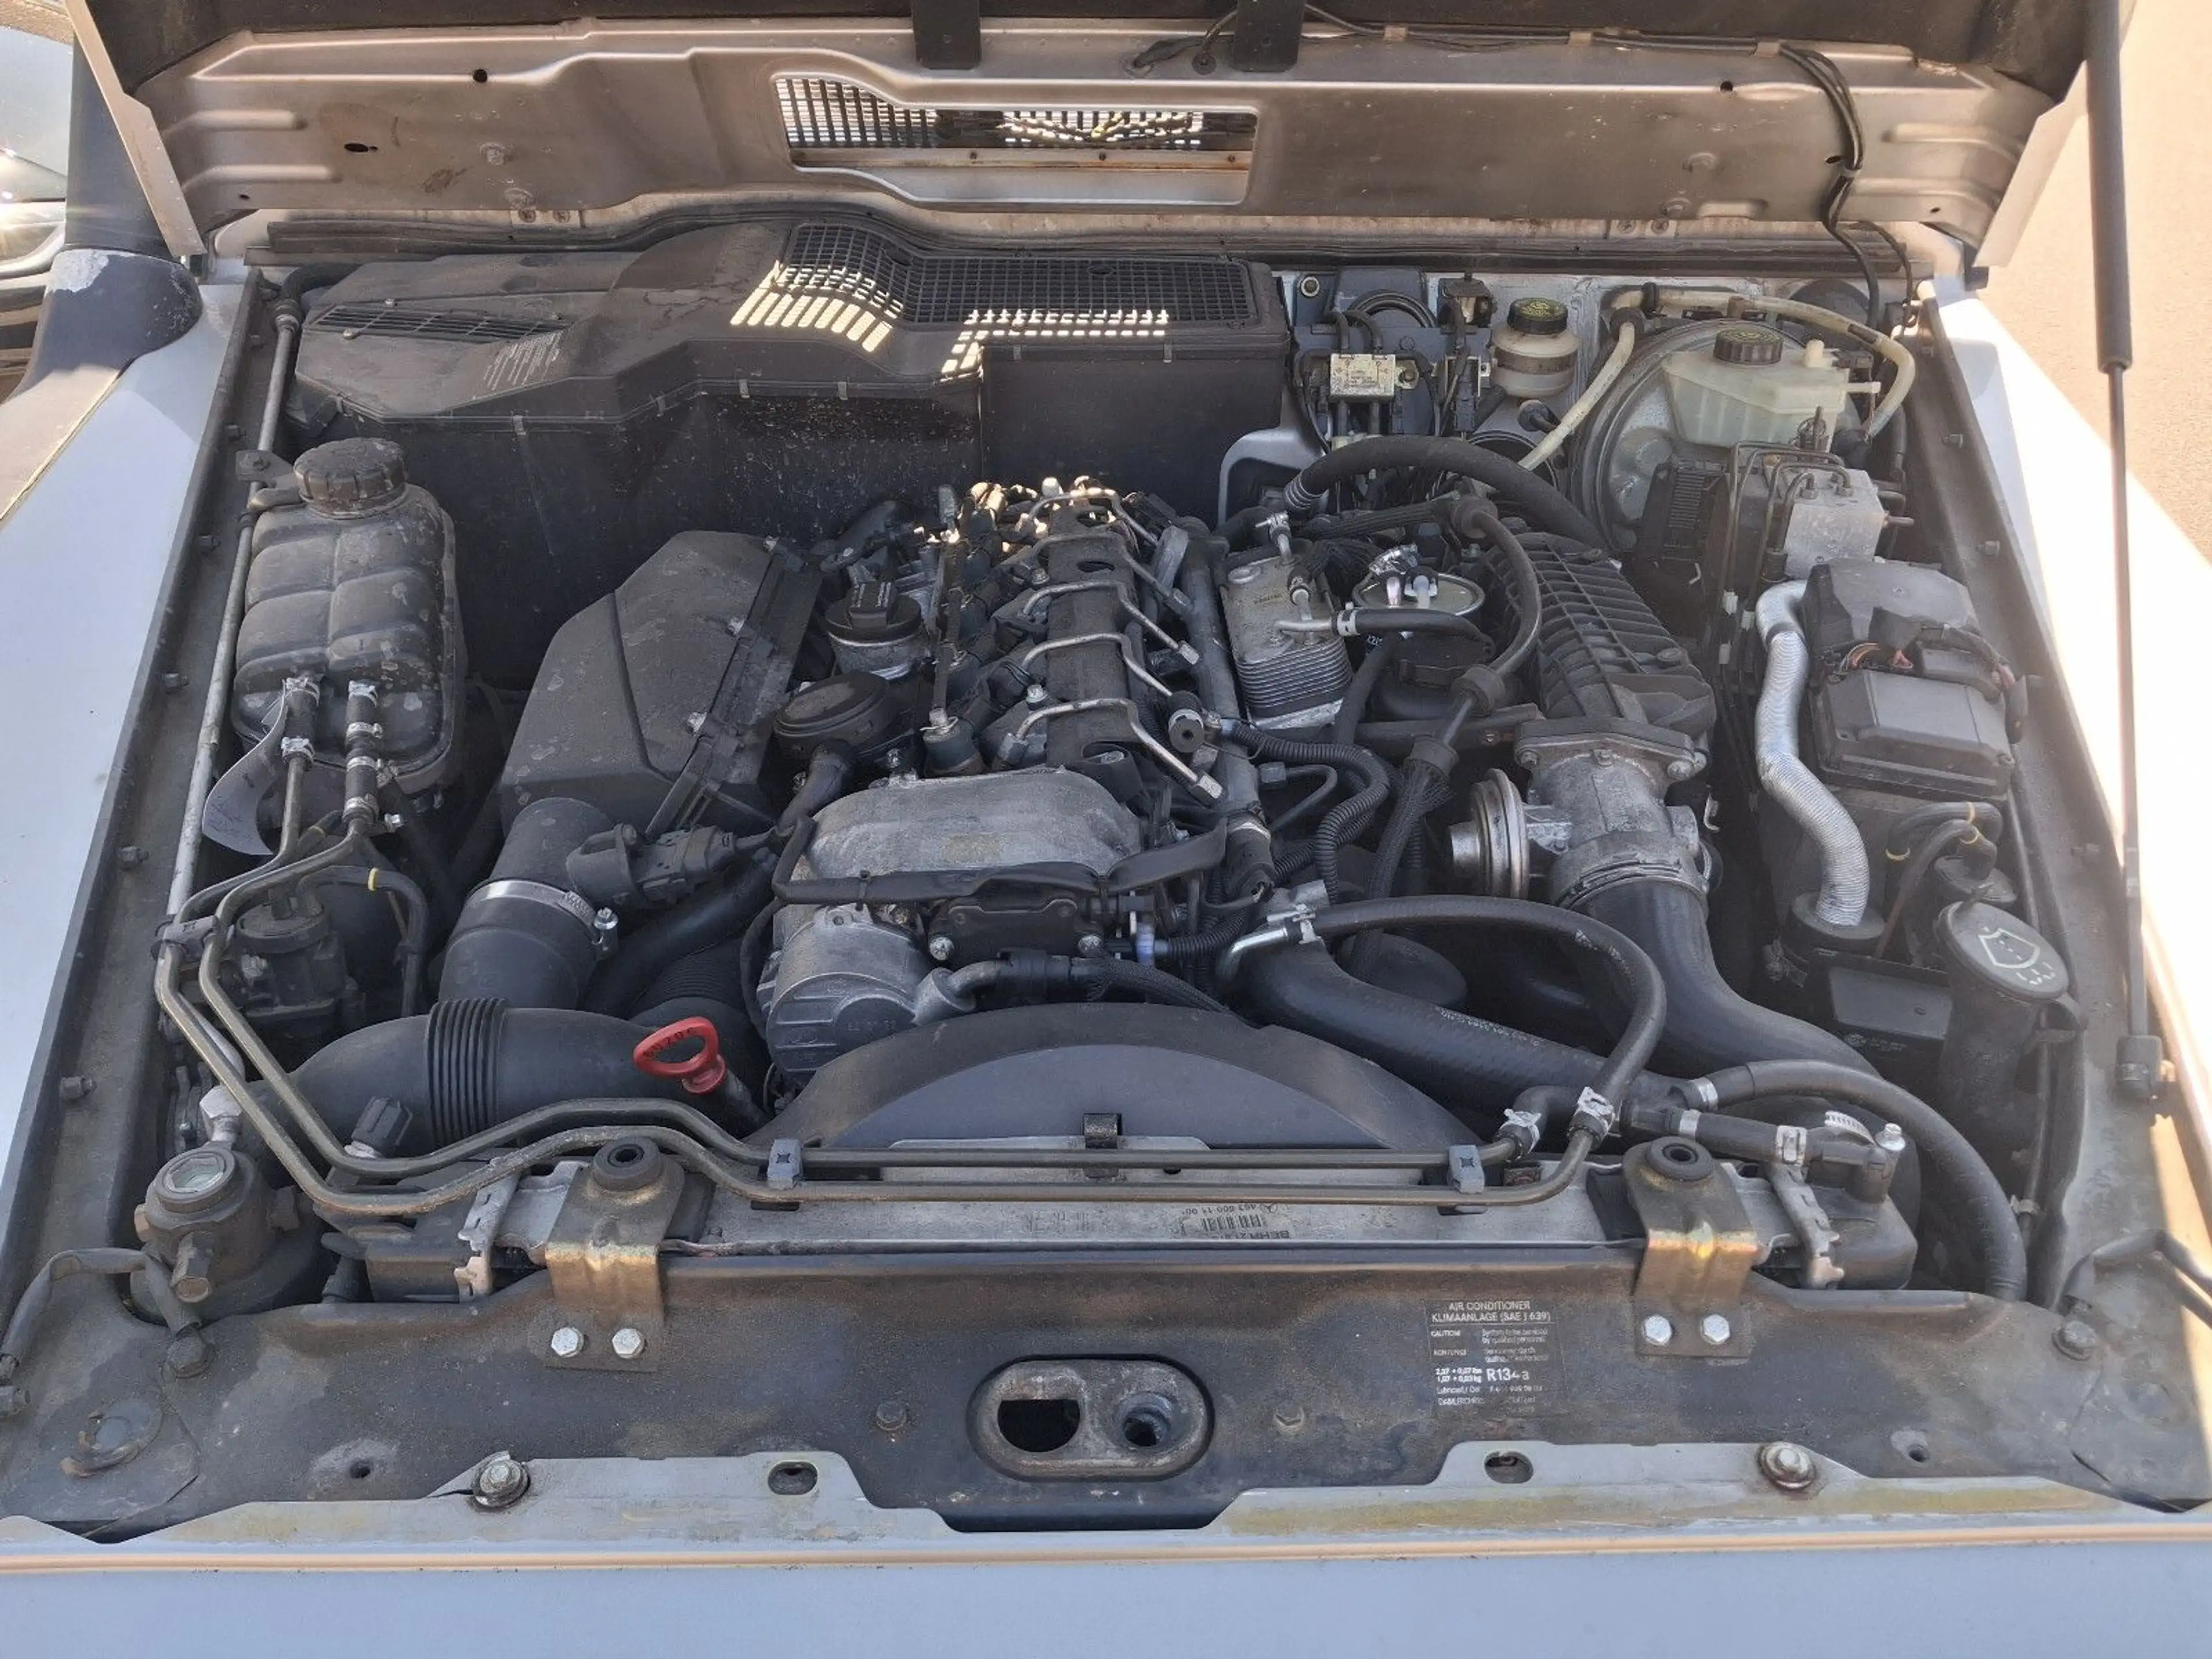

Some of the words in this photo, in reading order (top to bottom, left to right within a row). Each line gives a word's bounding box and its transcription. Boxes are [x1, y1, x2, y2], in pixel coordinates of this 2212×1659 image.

[1449, 1302, 1464, 1310] AIR
[1467, 1301, 1531, 1310] CONDITIONER
[1431, 1312, 1498, 1322] KLIMAANLAGE
